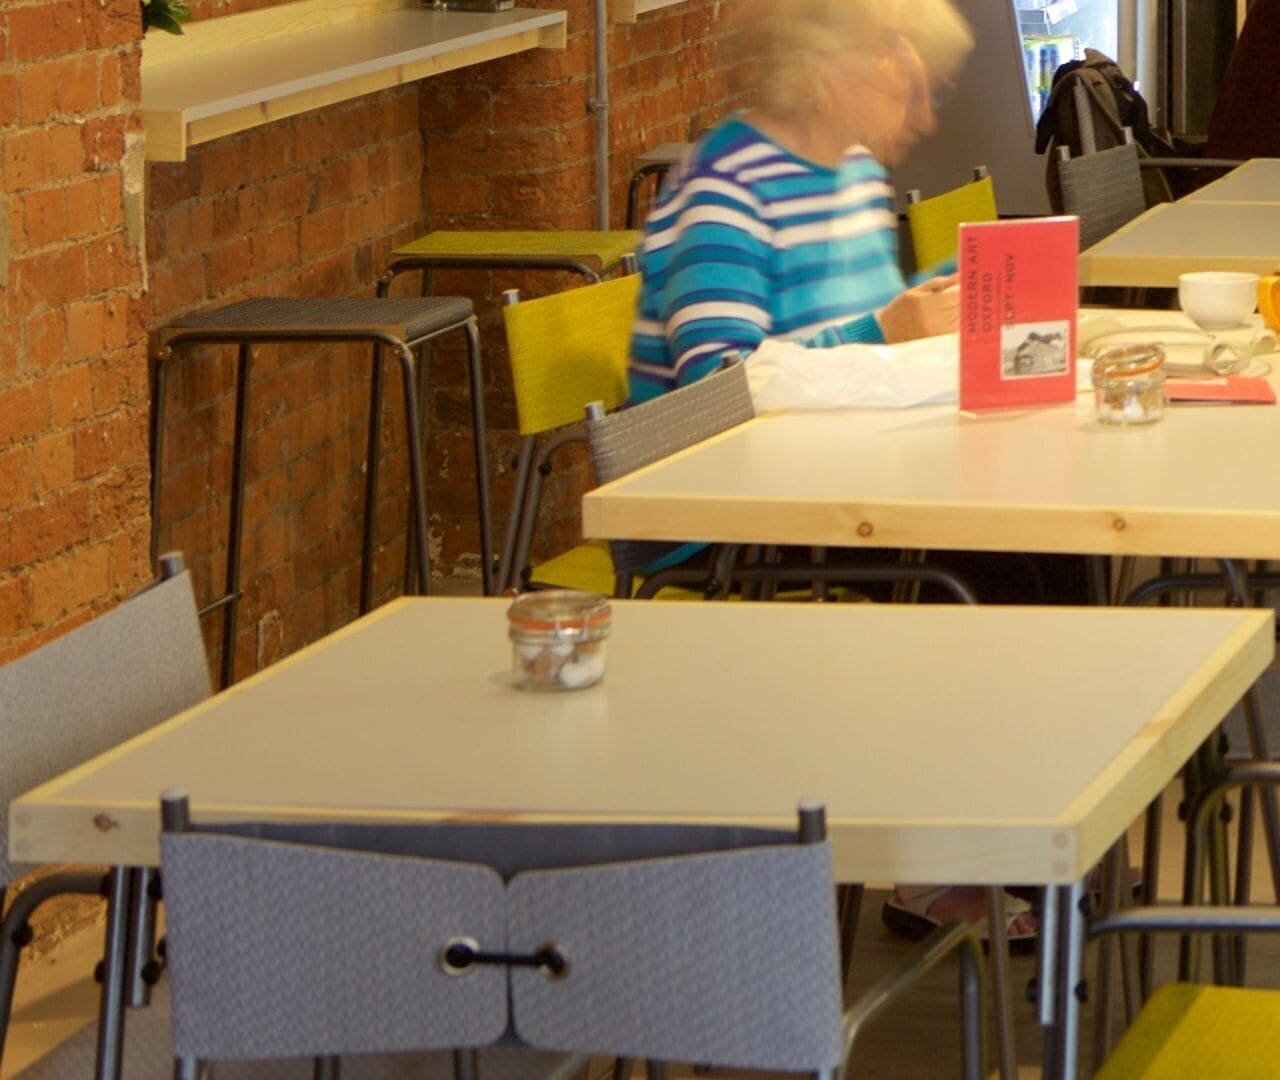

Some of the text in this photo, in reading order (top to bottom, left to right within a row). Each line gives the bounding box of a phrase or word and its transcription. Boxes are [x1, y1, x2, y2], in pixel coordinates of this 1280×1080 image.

[967, 236, 978, 332] MODERN ART
[982, 273, 992, 332] OXFORD
